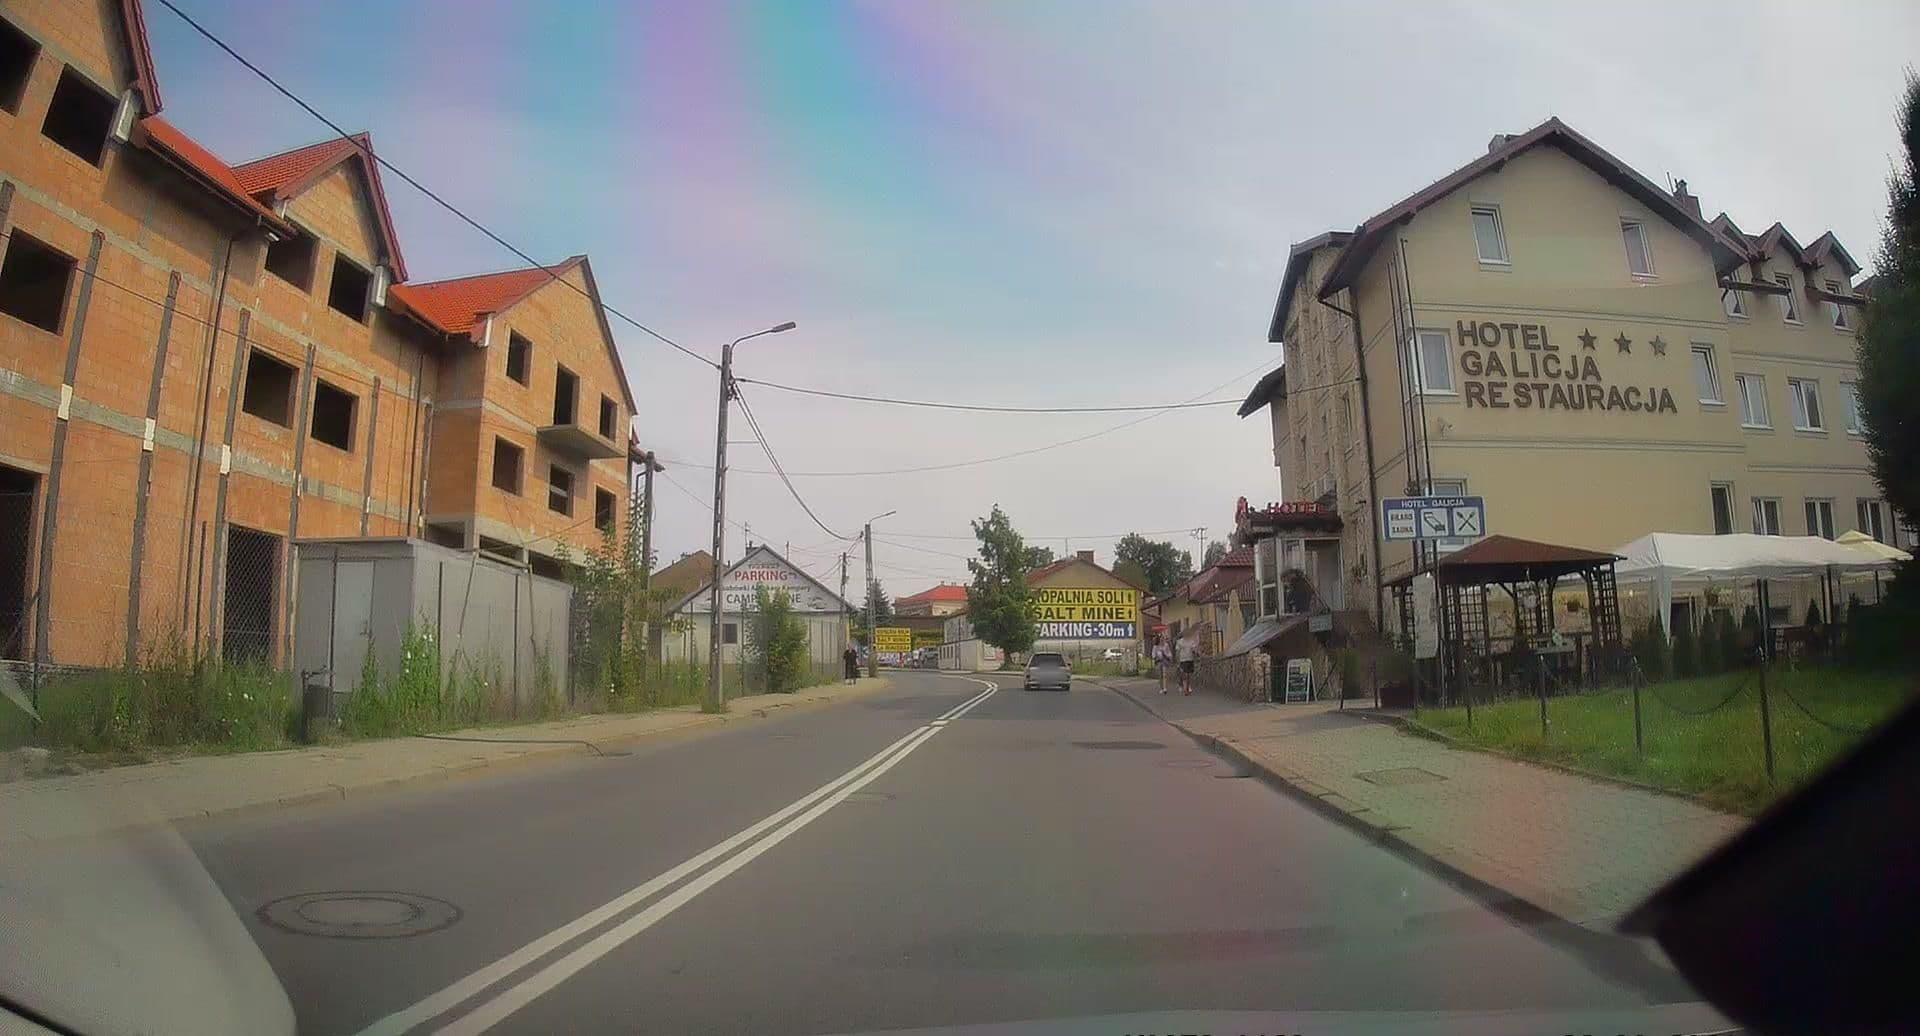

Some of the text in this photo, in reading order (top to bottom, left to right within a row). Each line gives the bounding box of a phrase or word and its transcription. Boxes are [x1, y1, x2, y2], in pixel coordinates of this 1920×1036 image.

[1457, 320, 1559, 351] HOTEL
[1460, 351, 1602, 381] GALICJA
[1464, 381, 1678, 414] RESTAURACJA
[1401, 499, 1465, 508] HOTEL GALICJA
[735, 570, 788, 581] PARKING
[1097, 591, 1124, 604] SOLI
[1082, 607, 1124, 620] MINE
